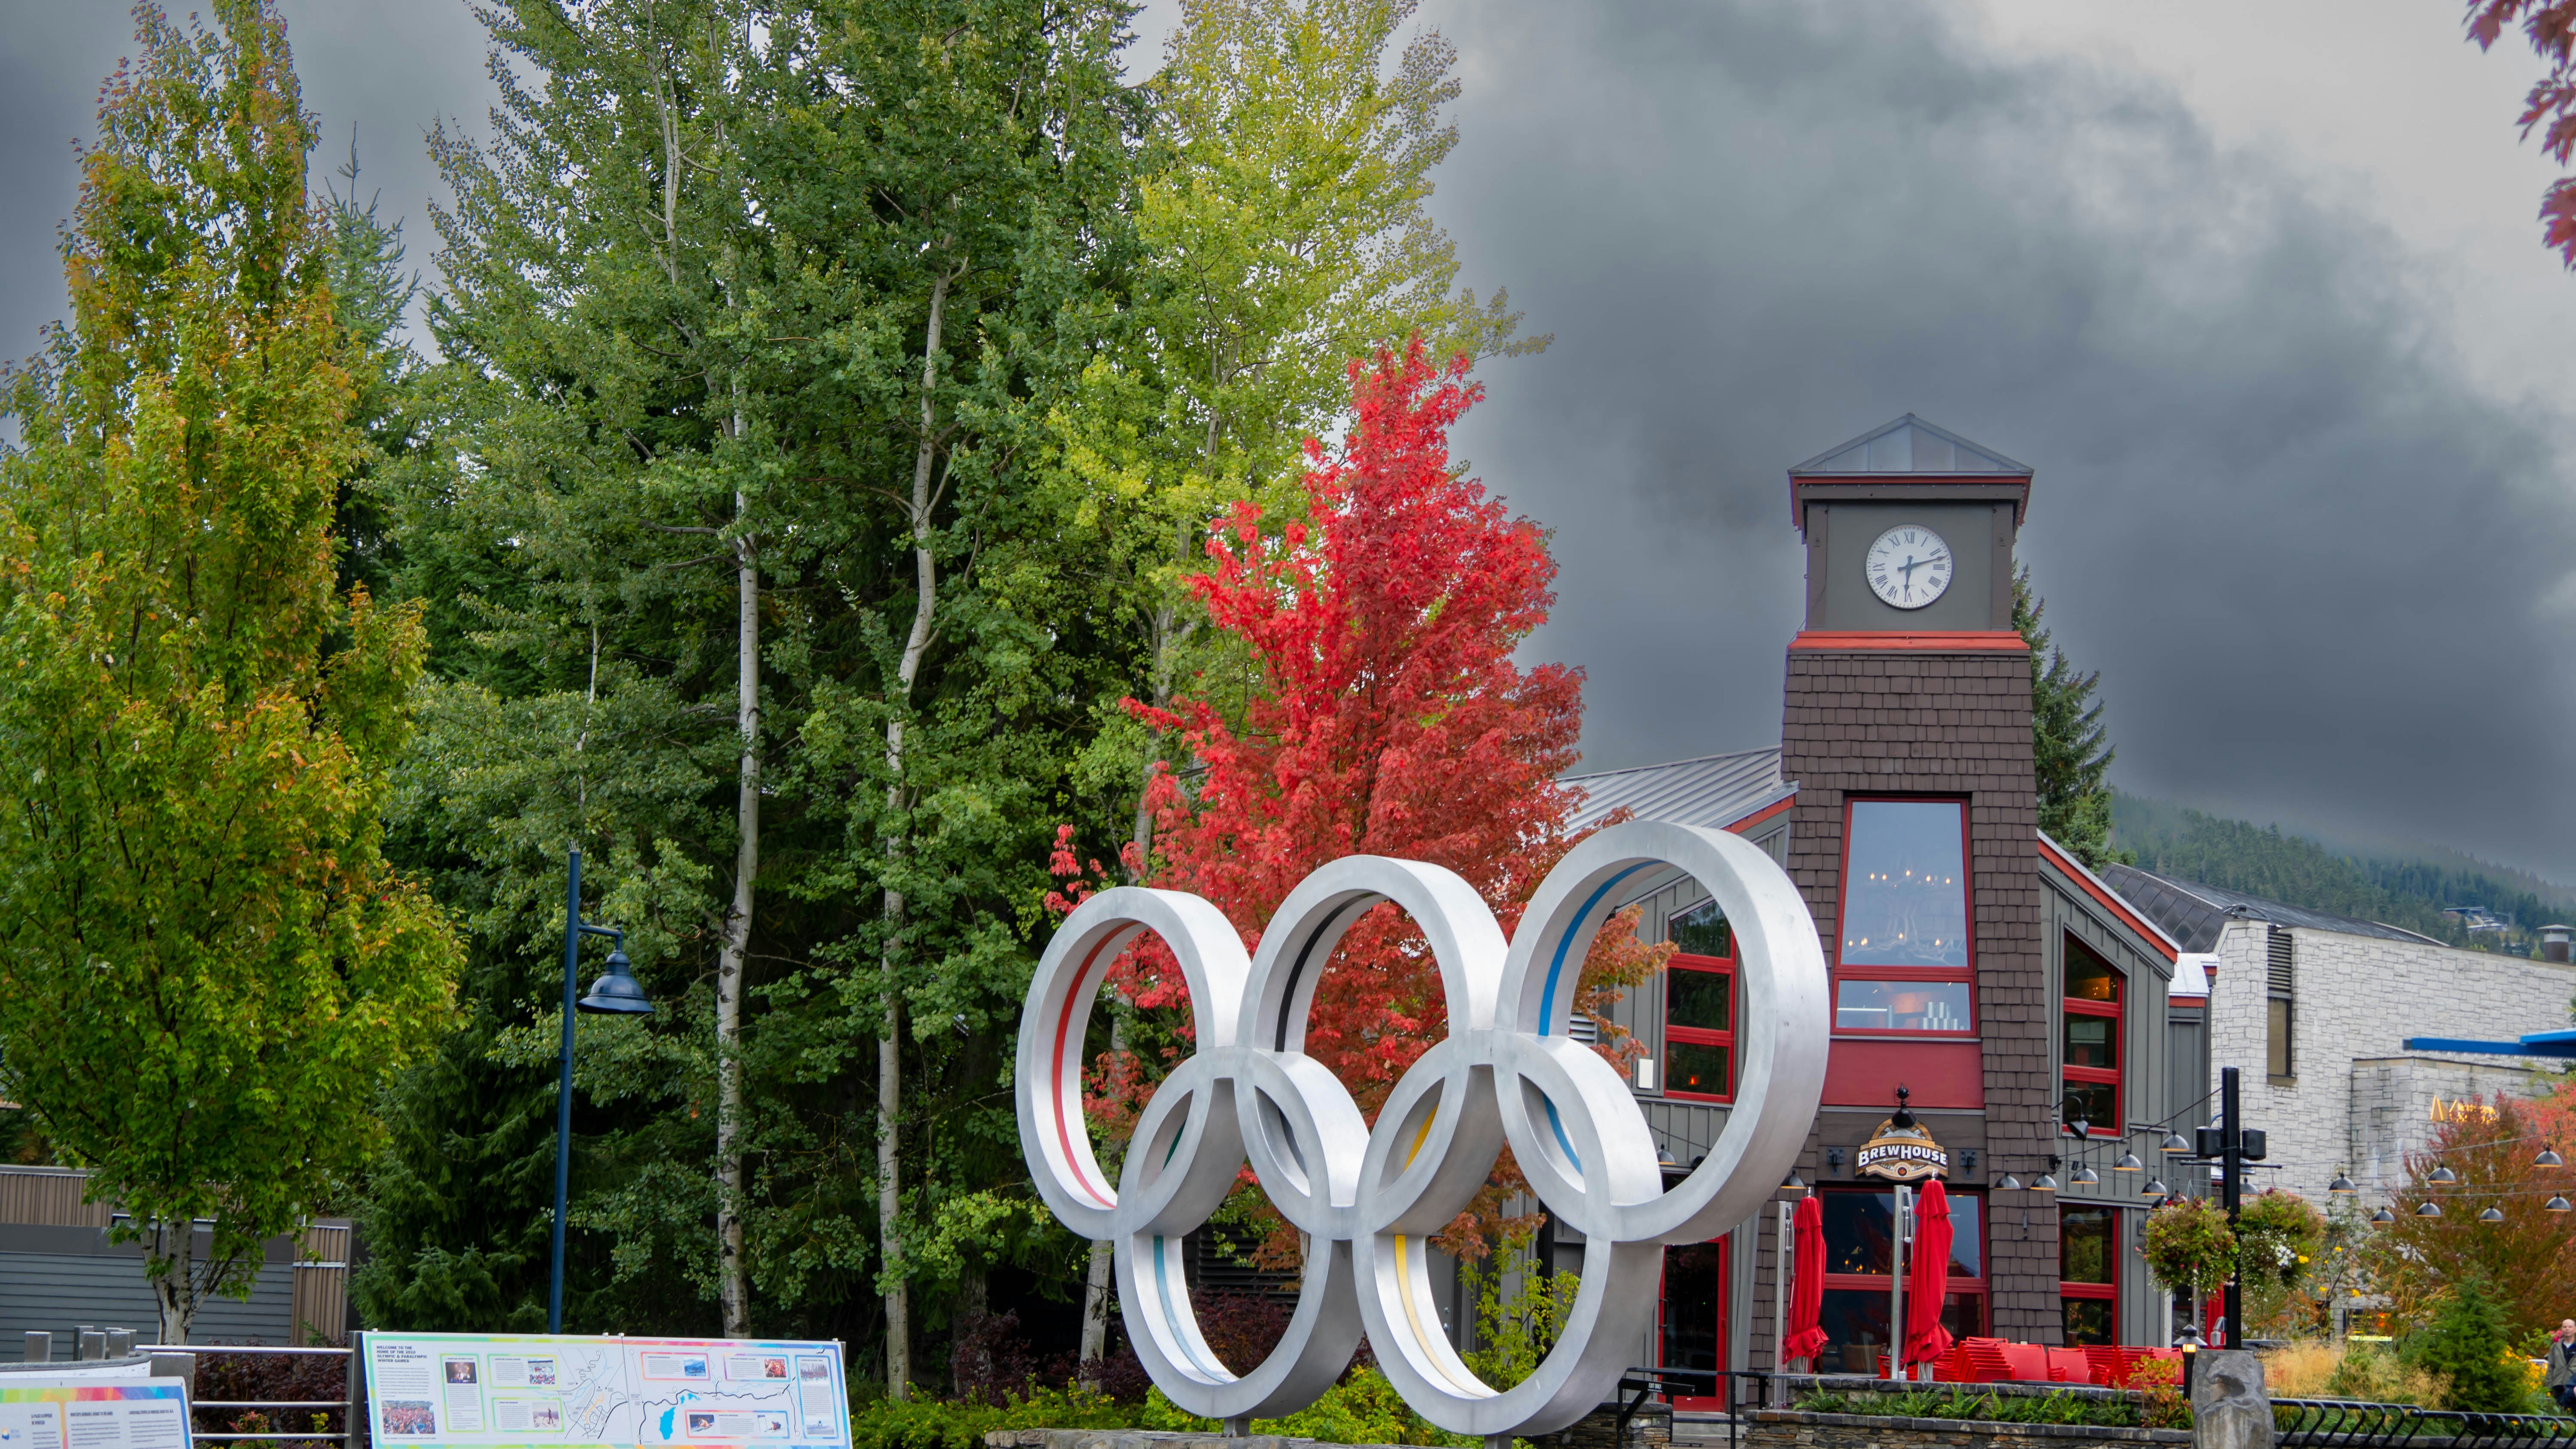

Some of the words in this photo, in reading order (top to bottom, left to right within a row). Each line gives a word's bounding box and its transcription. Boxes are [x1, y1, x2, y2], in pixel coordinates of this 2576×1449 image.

[1888, 535, 1901, 548] XI
[1904, 532, 1915, 544] XII
[1921, 536, 1928, 547] I
[1877, 547, 1889, 557] X
[1929, 548, 1941, 556] II
[1873, 562, 1885, 571] IX
[1875, 574, 1889, 589] VIII
[1886, 585, 1898, 599] VII
[1921, 588, 1929, 599] V
